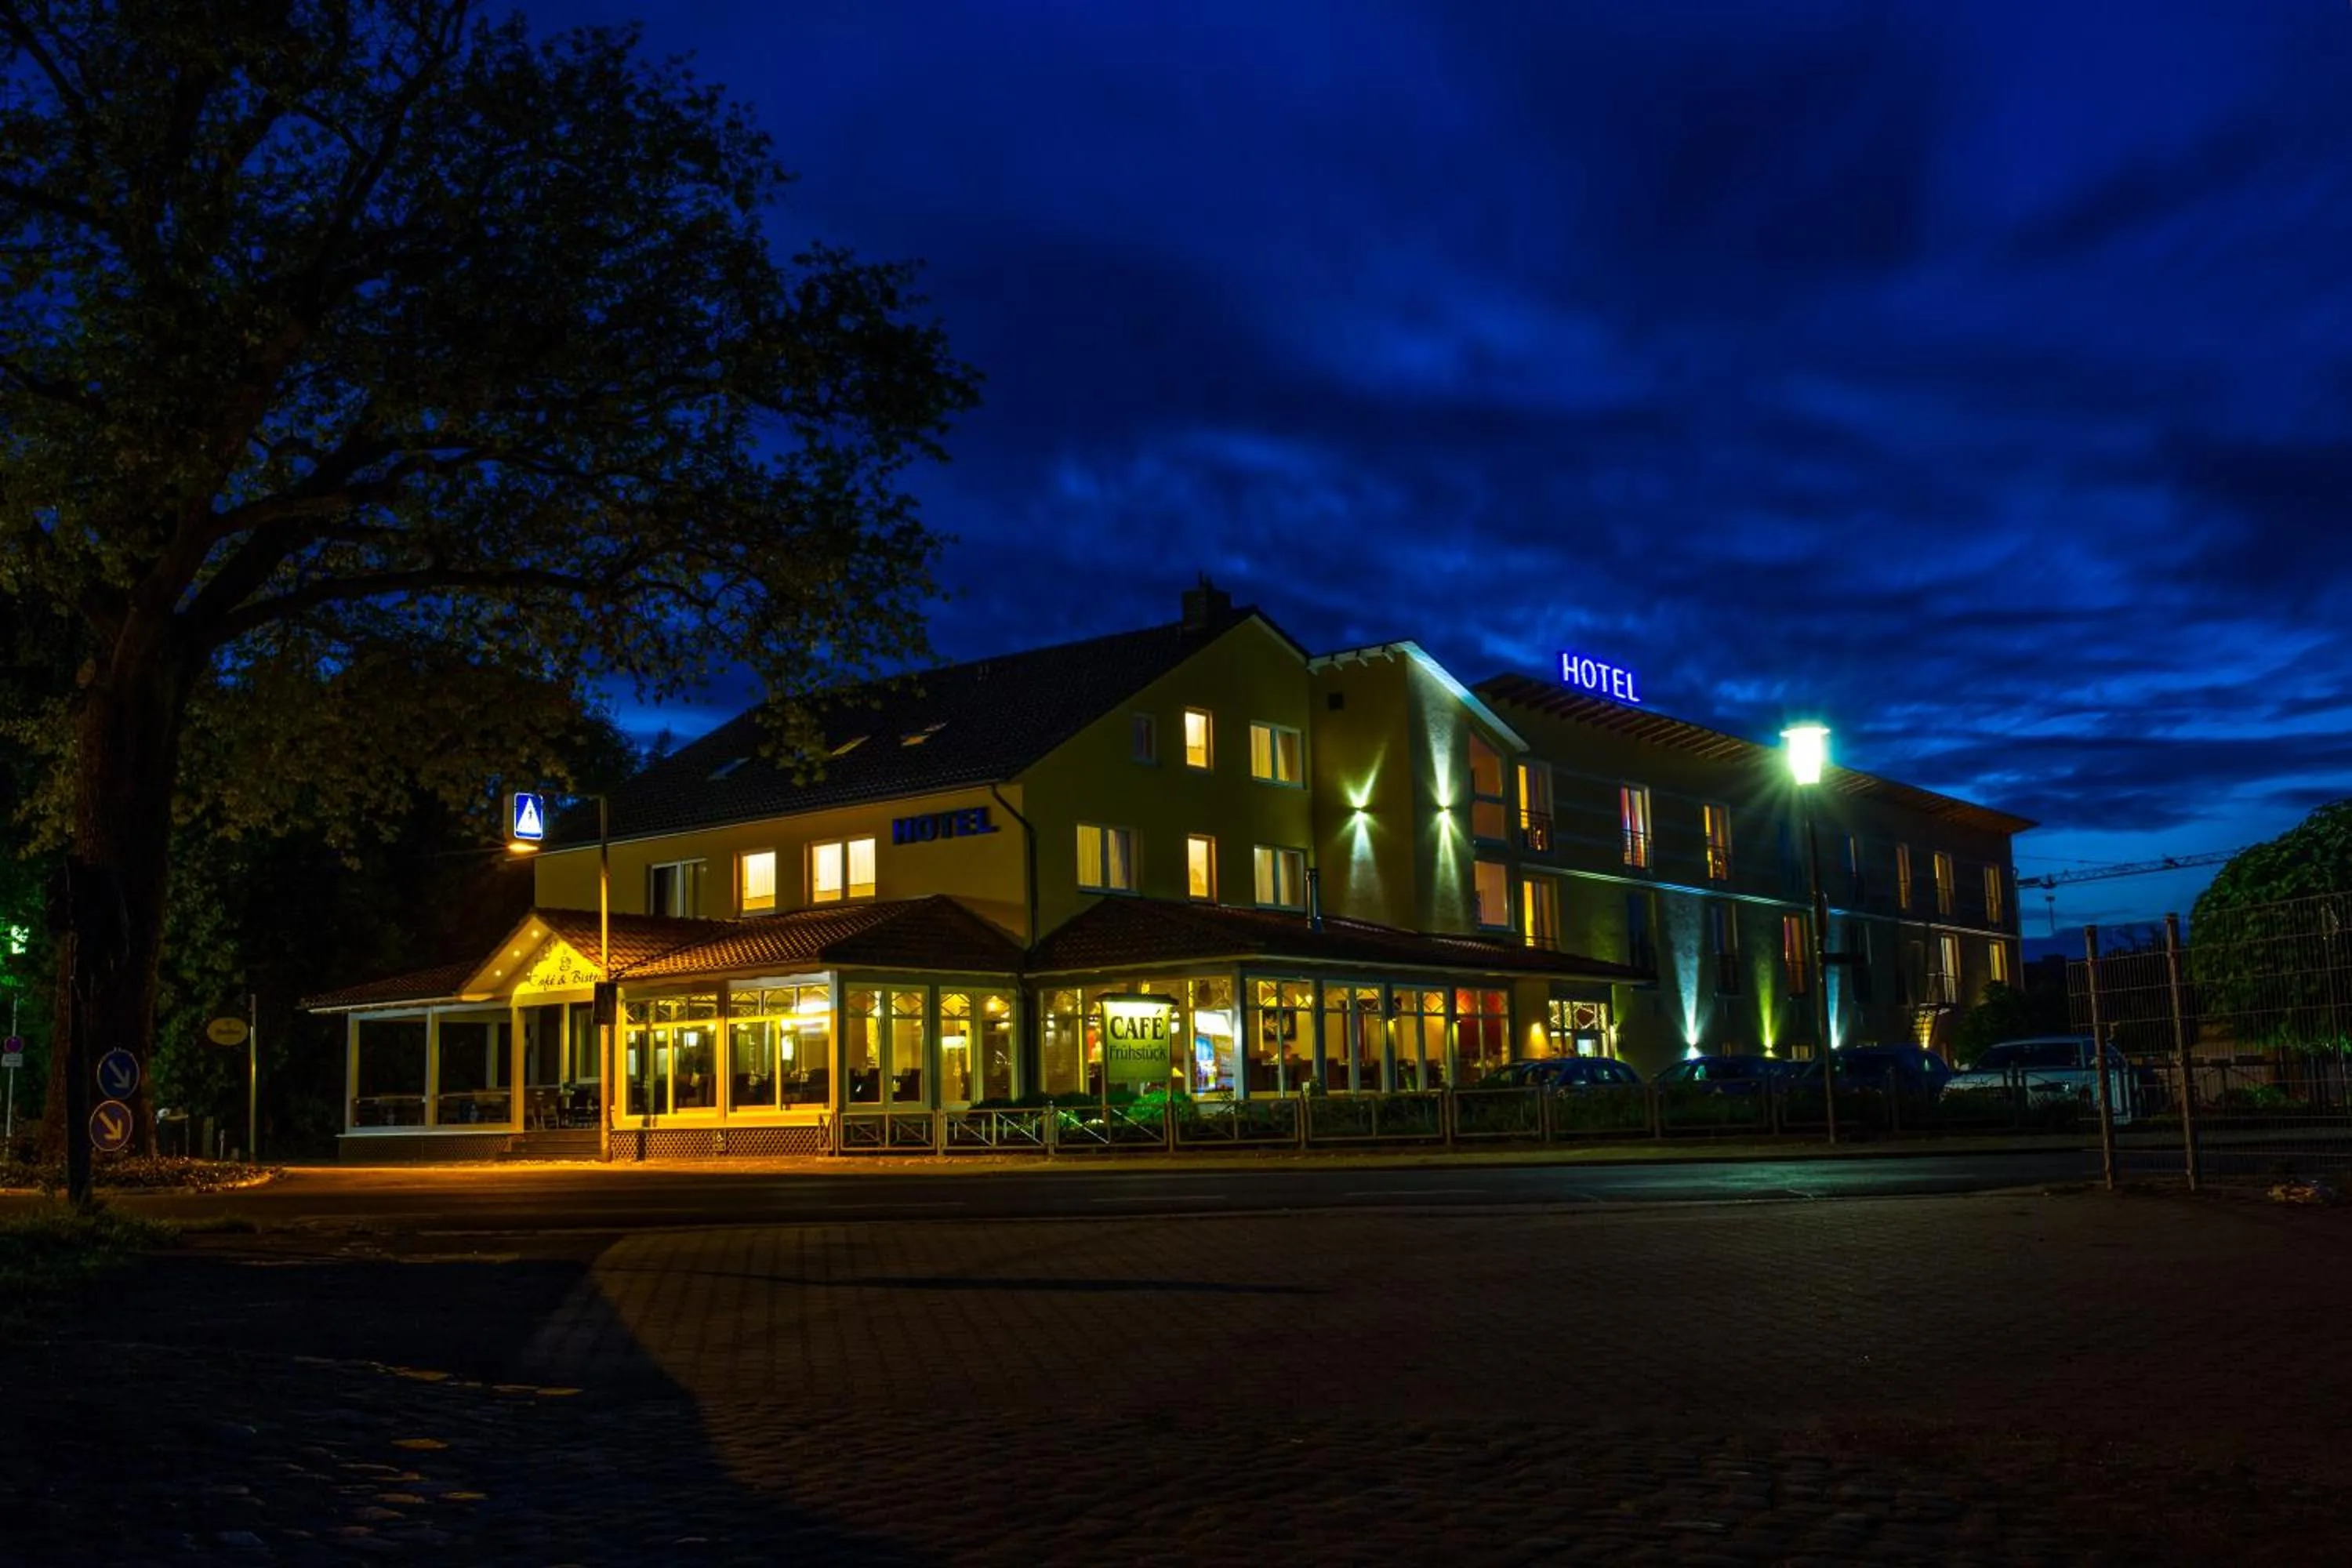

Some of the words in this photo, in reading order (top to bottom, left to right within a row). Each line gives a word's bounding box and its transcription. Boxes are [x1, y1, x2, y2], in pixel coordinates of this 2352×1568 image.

[1562, 652, 1641, 702] HOTEL
[892, 807, 1000, 845] HOTEL
[1109, 1008, 1165, 1040] CAFÉ
[1109, 1044, 1167, 1062] Frühstück
